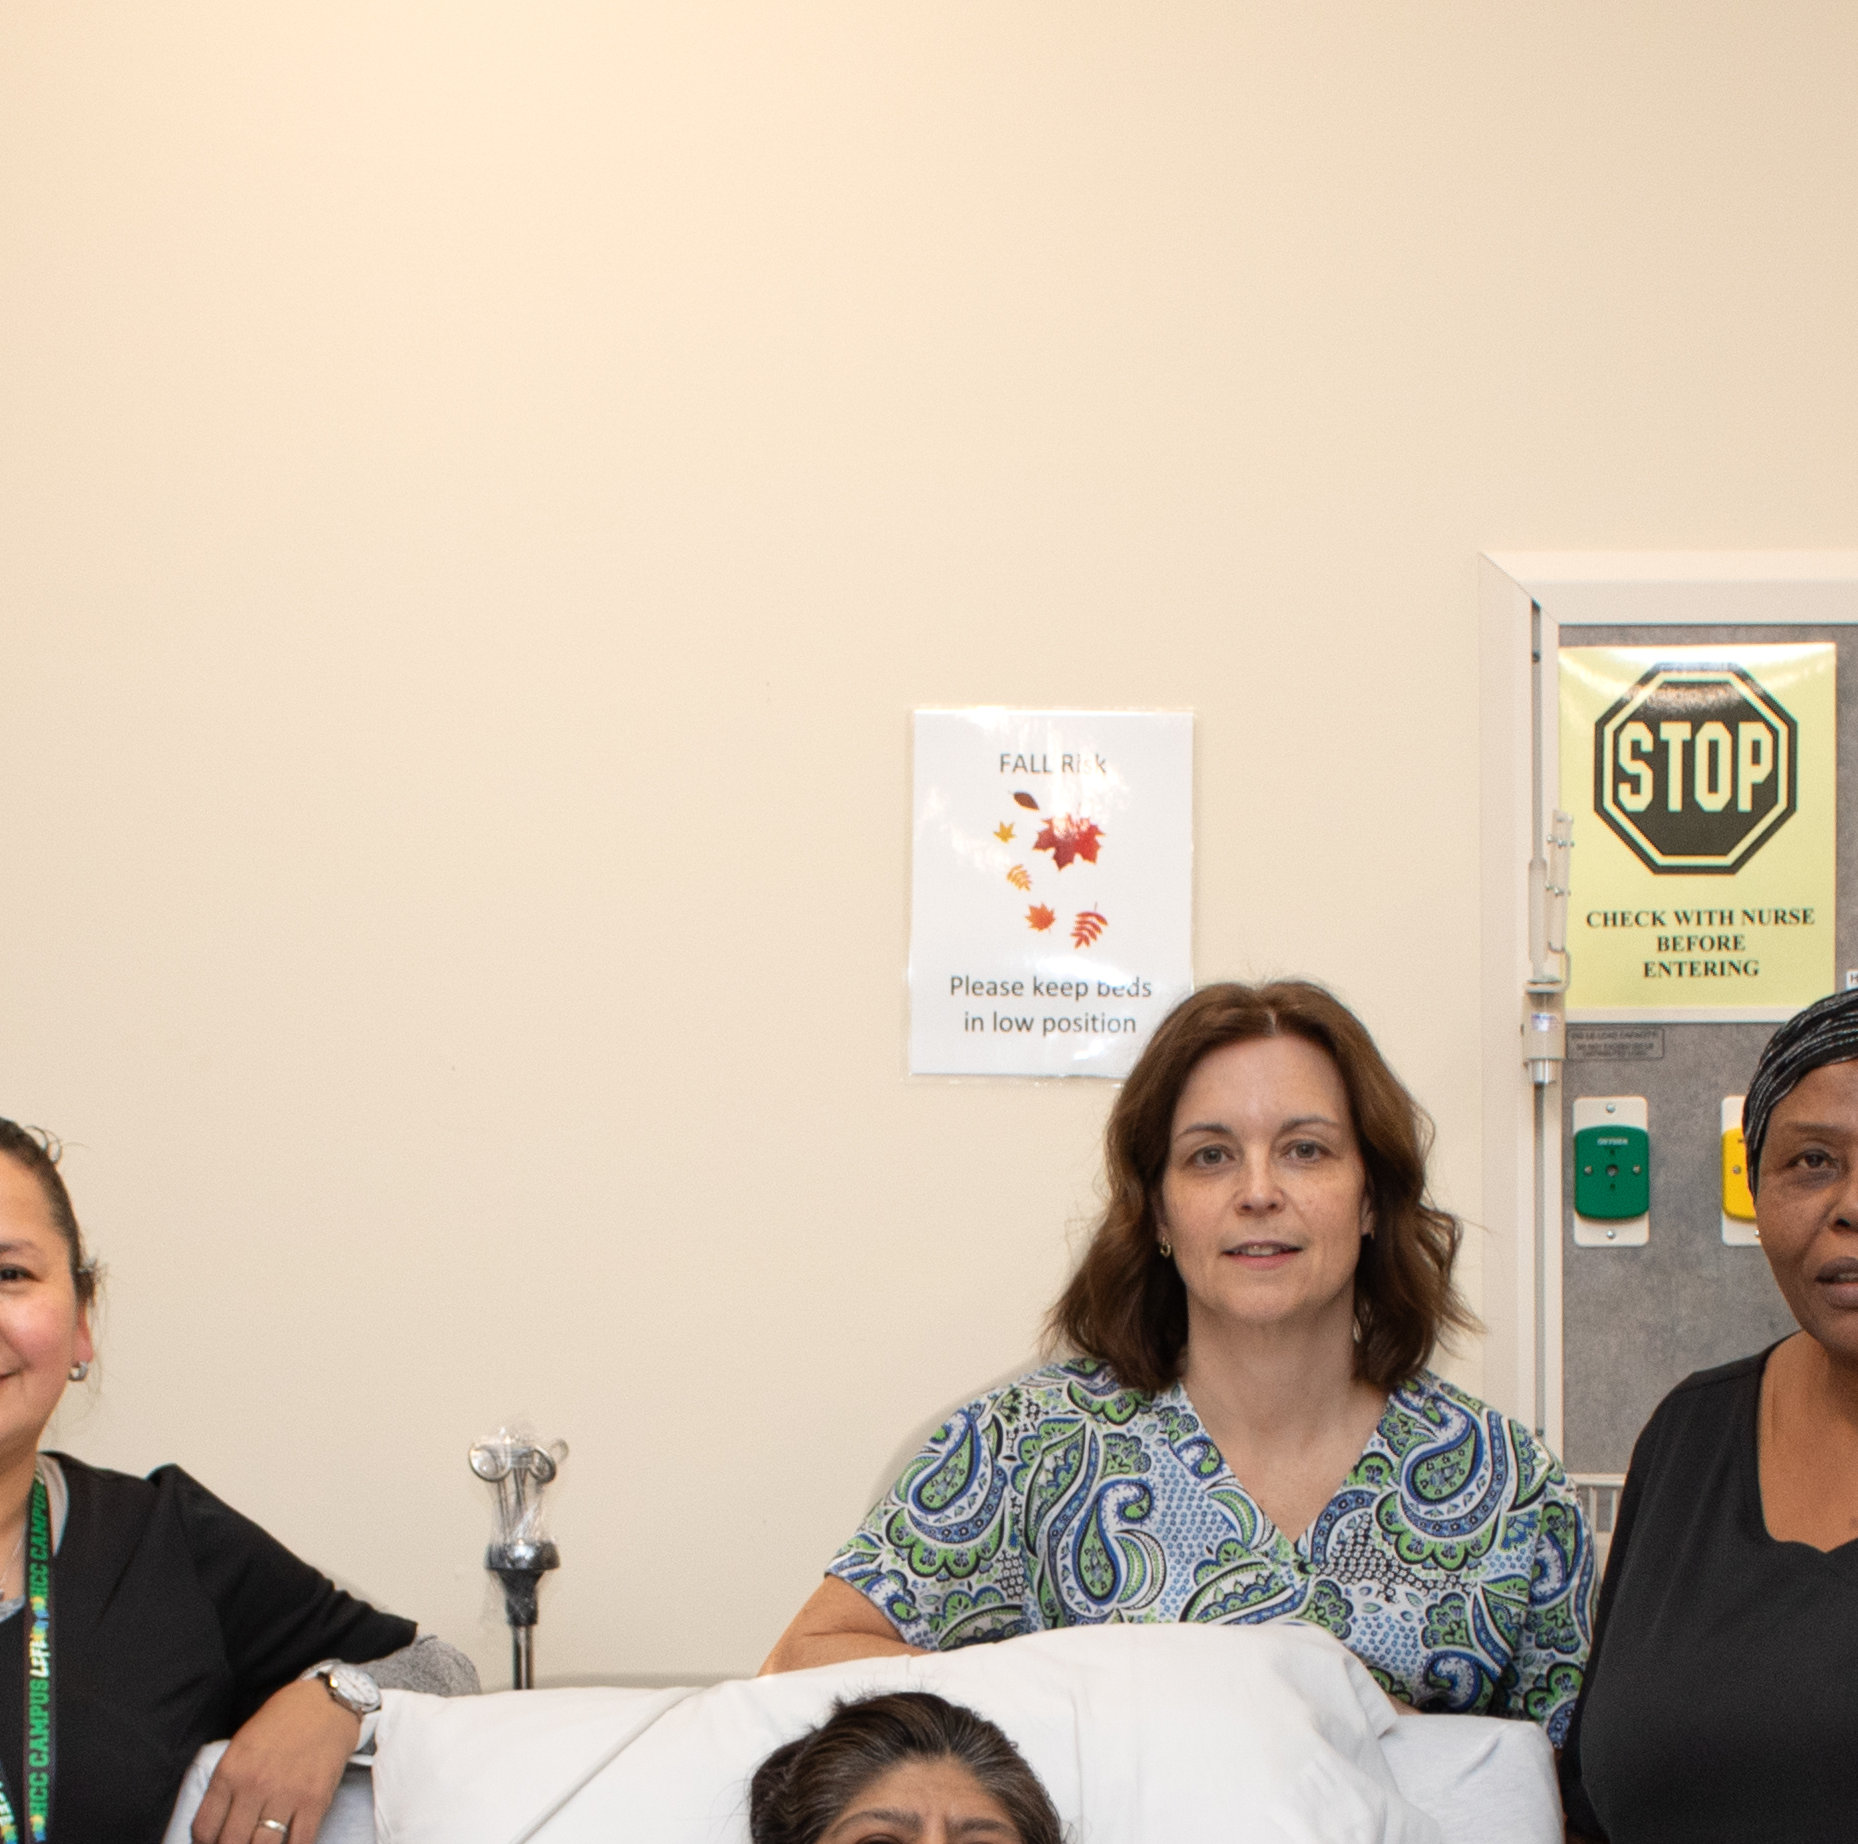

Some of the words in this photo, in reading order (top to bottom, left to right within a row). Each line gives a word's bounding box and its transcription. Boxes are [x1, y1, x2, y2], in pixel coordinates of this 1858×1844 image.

[999, 753, 1052, 774] FALL
[1617, 721, 1774, 812] STOP
[1586, 910, 1669, 929] CHECK
[1674, 909, 1736, 928] WITH
[1741, 908, 1816, 927] NURSE
[1656, 934, 1746, 953] BEFORE
[1642, 959, 1760, 979] ENTERING
[950, 975, 1024, 998] Please
[1032, 975, 1089, 1002] keep
[1097, 975, 1152, 998] beds
[964, 1012, 984, 1033] in
[992, 1011, 1034, 1033] low
[1042, 1011, 1136, 1037] position
[28, 1679, 50, 1768] CAMPUS
